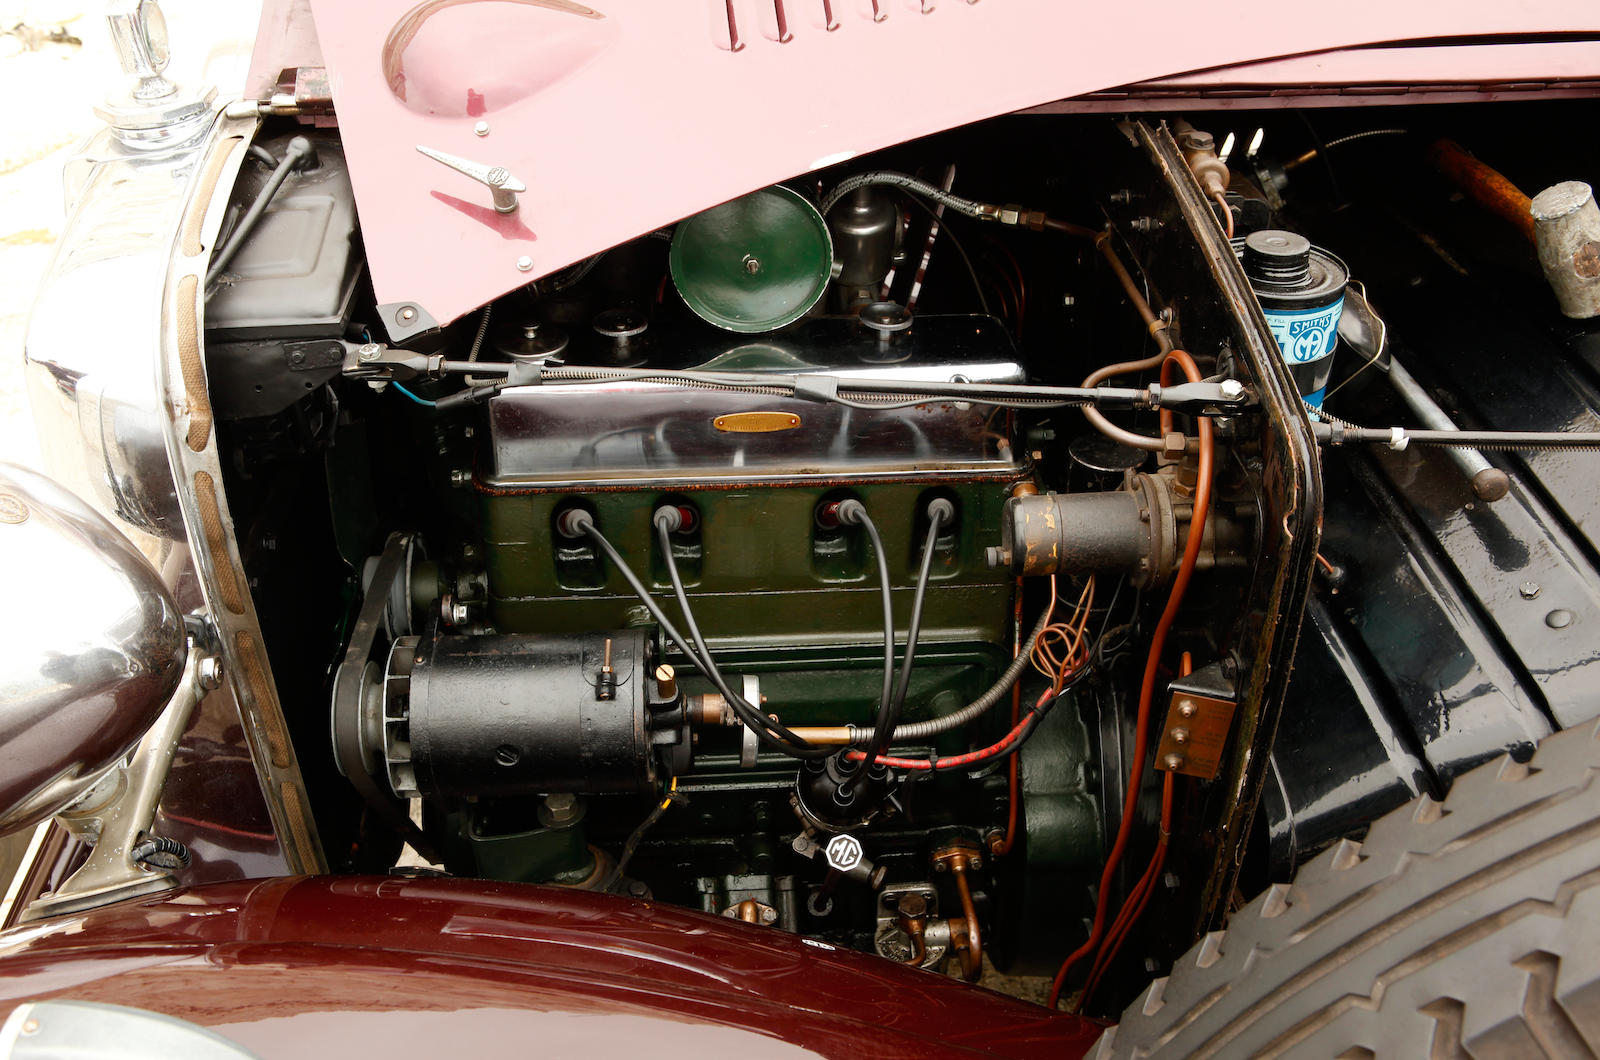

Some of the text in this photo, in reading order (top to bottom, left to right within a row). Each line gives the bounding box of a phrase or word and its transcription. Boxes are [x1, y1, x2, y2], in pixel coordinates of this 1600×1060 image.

[1292, 314, 1331, 334] SMITHS
[1208, 708, 1229, 716] BRAKE
[1191, 739, 1219, 748] SHACKLE
[830, 838, 859, 867] MG
